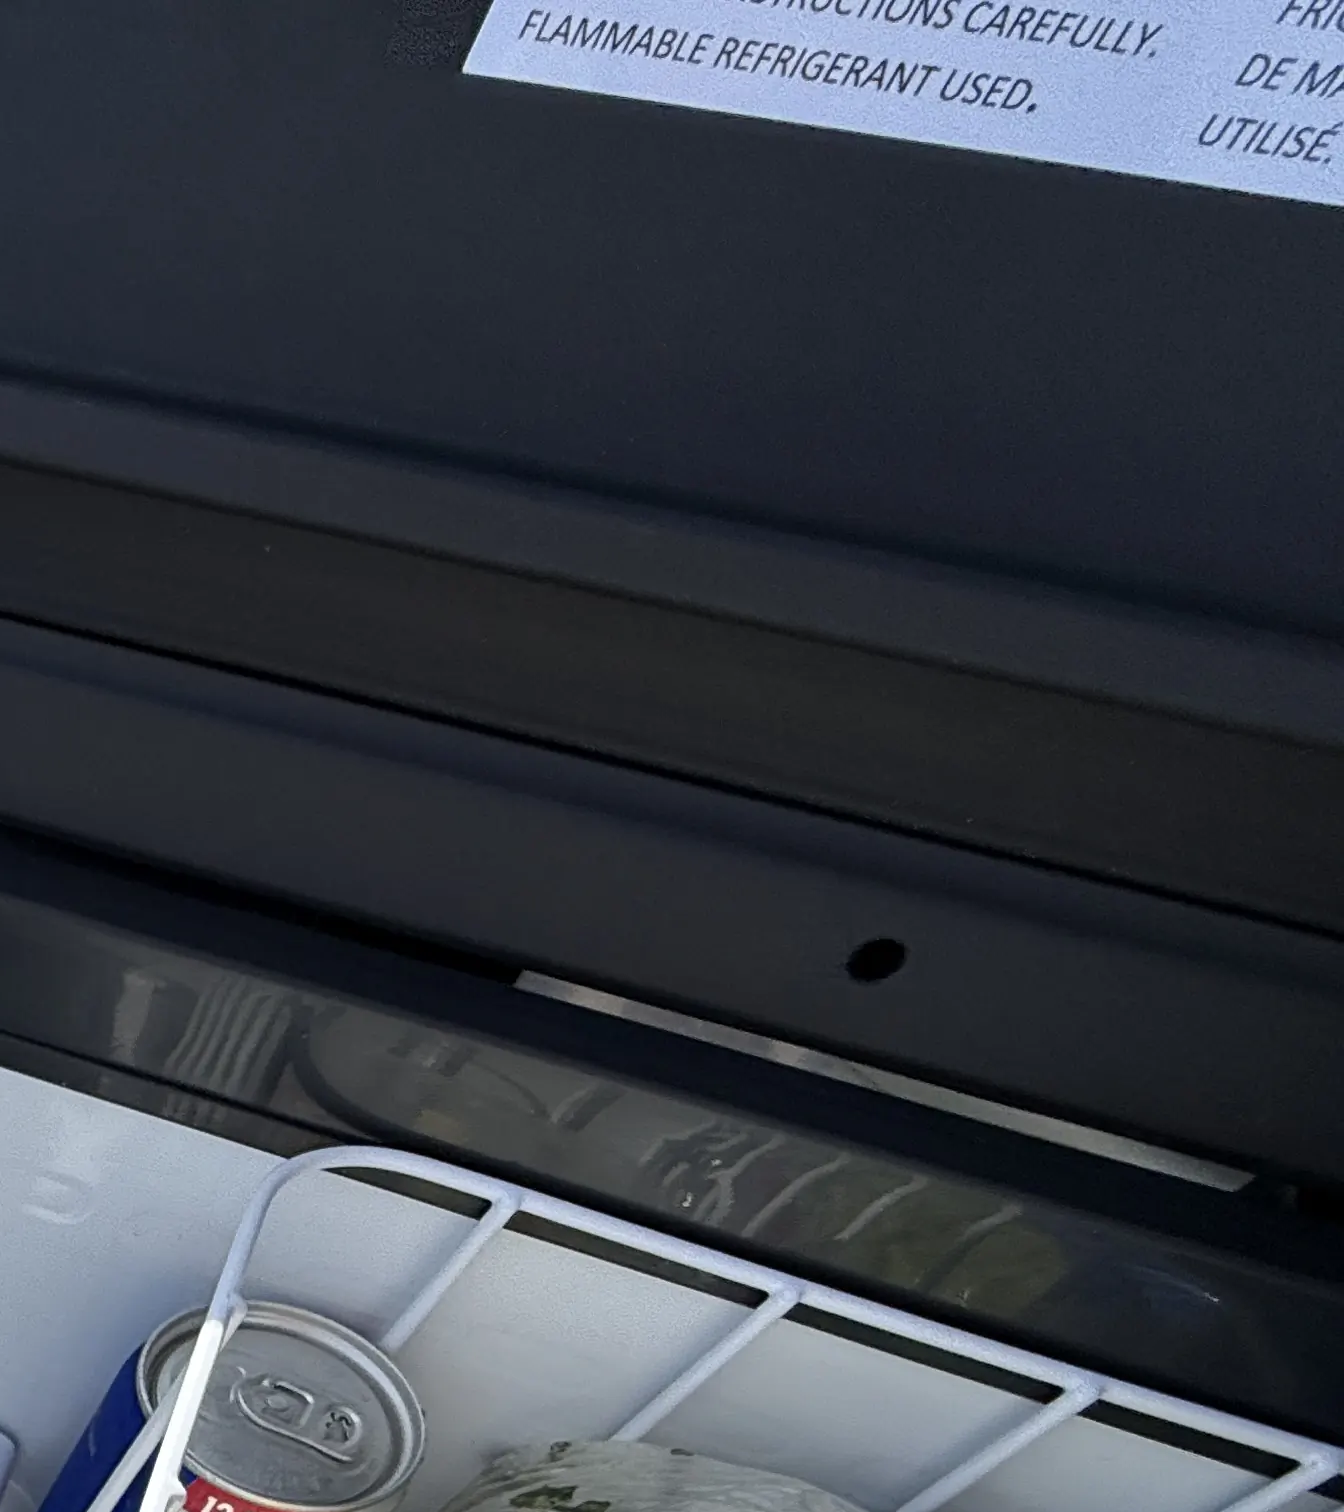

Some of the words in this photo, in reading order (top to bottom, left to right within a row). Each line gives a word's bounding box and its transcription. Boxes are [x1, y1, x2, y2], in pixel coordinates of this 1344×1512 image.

[963, 0, 1164, 58] CAREFULLY.
[518, 9, 714, 65] FLAMMABLE
[713, 36, 942, 97] REFRIGERANT
[939, 69, 1038, 114] USED.
[1235, 53, 1299, 91] DE
[1291, 60, 1344, 99] M
[1198, 113, 1343, 165] UTILISÉ.
